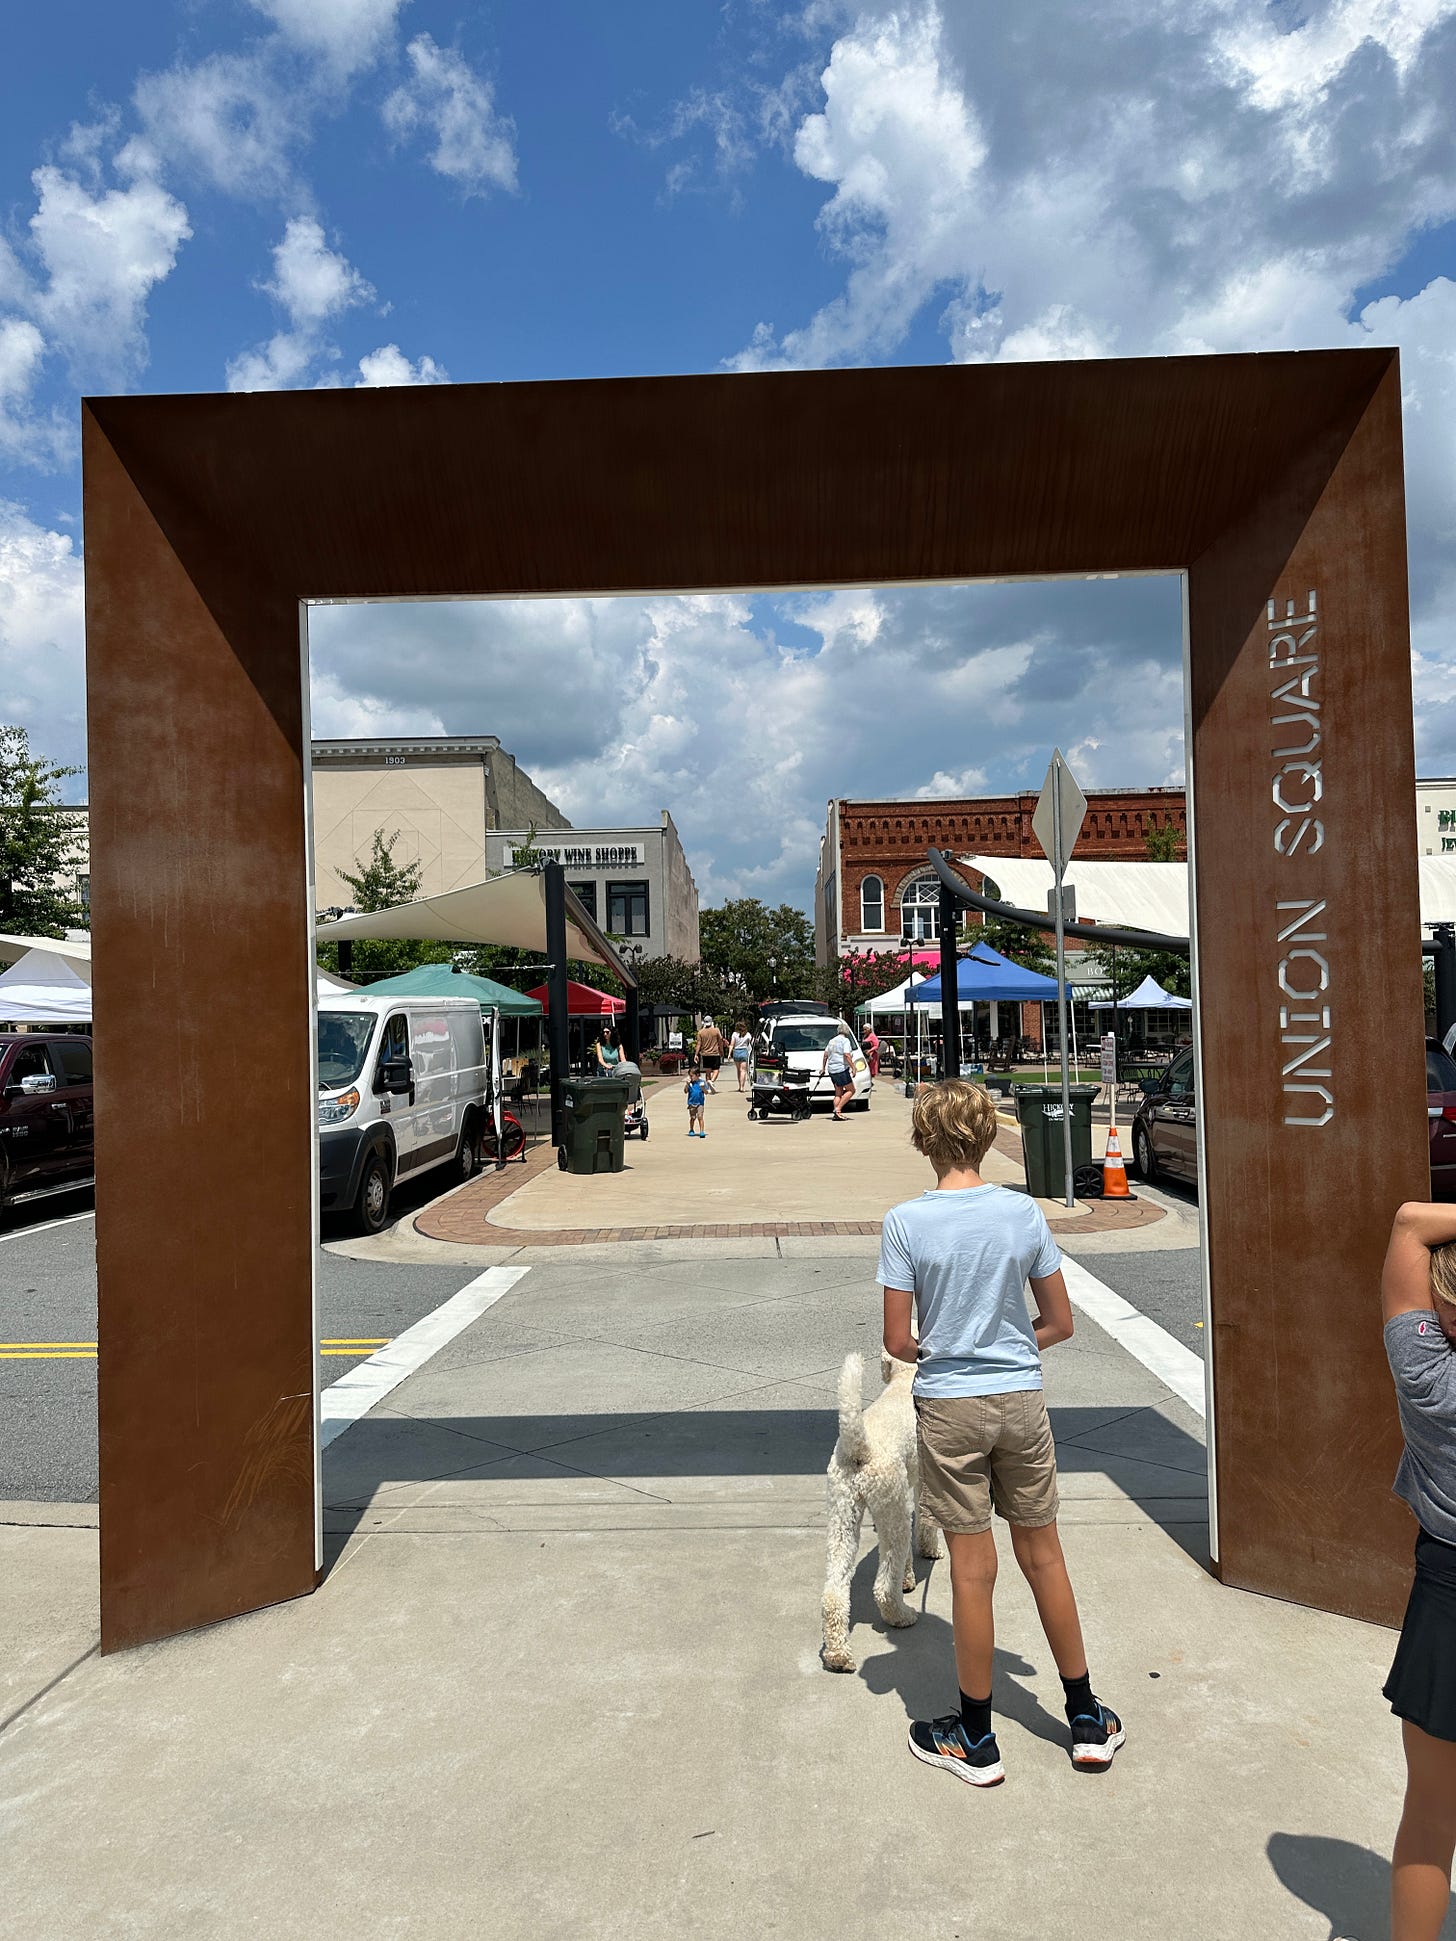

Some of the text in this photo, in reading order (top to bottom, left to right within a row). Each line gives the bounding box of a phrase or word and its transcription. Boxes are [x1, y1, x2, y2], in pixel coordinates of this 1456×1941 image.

[385, 756, 406, 764] 1903
[511, 847, 637, 862] HORY WINE SHOPPE
[1266, 589, 1334, 1126] UNION SQUARE
[1042, 1103, 1074, 1111] HICKY
